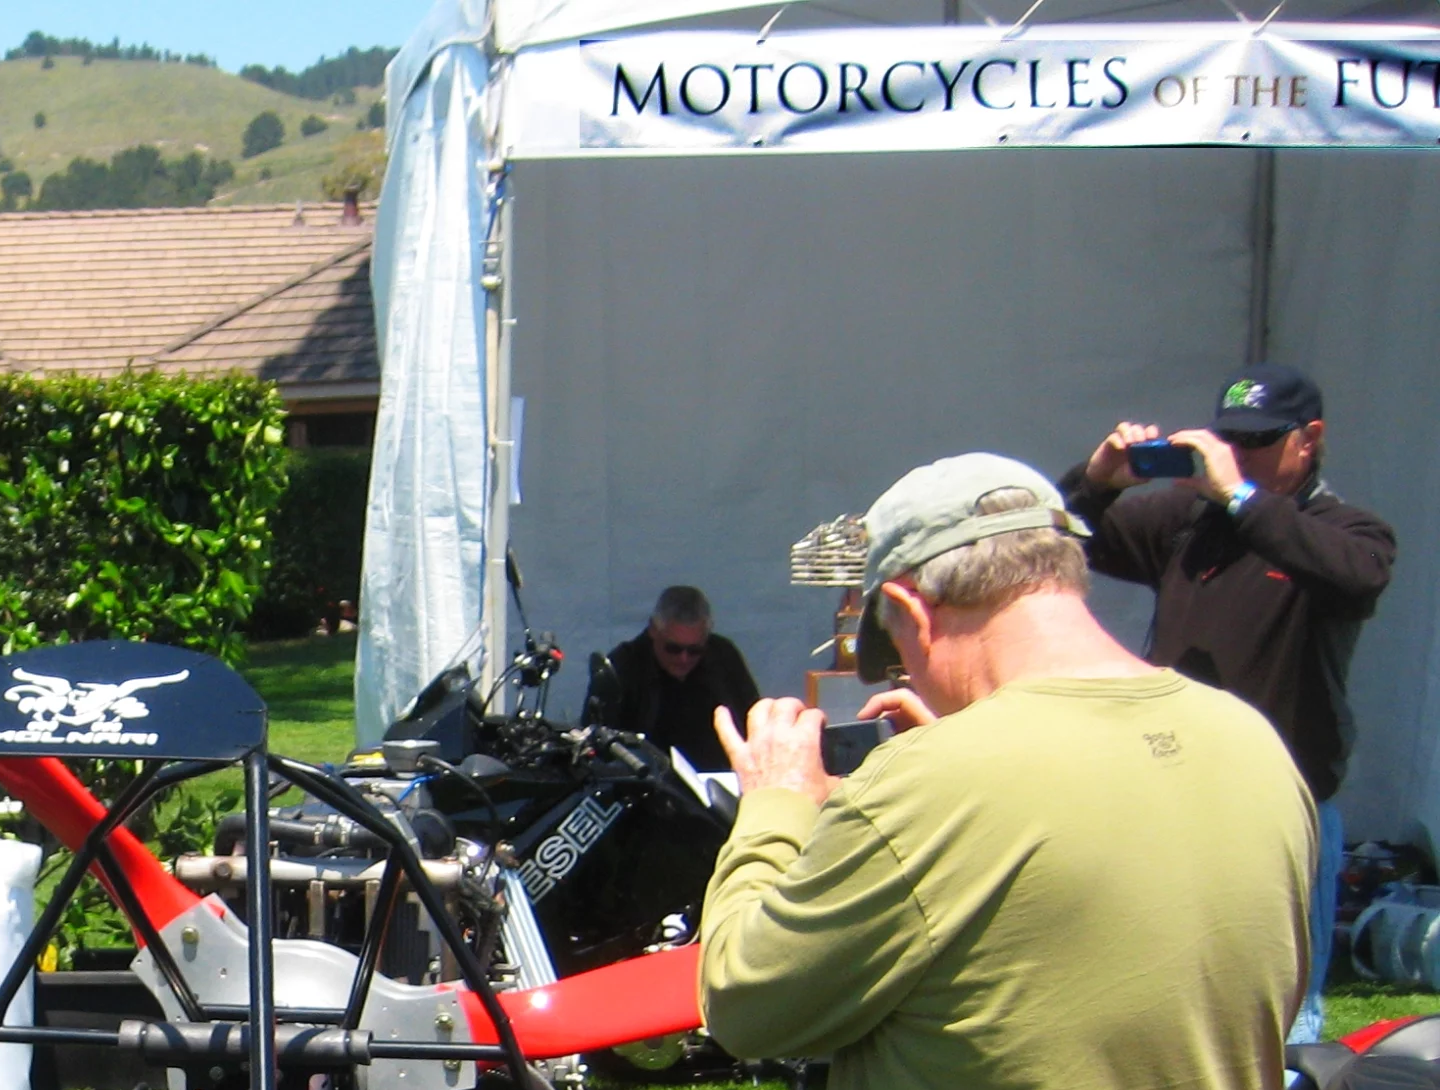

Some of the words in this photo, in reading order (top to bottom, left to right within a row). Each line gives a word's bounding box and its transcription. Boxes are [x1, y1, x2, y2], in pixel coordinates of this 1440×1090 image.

[610, 55, 1129, 118] MOTORCYCLES
[1153, 74, 1208, 108] OF
[1224, 74, 1308, 108] THE
